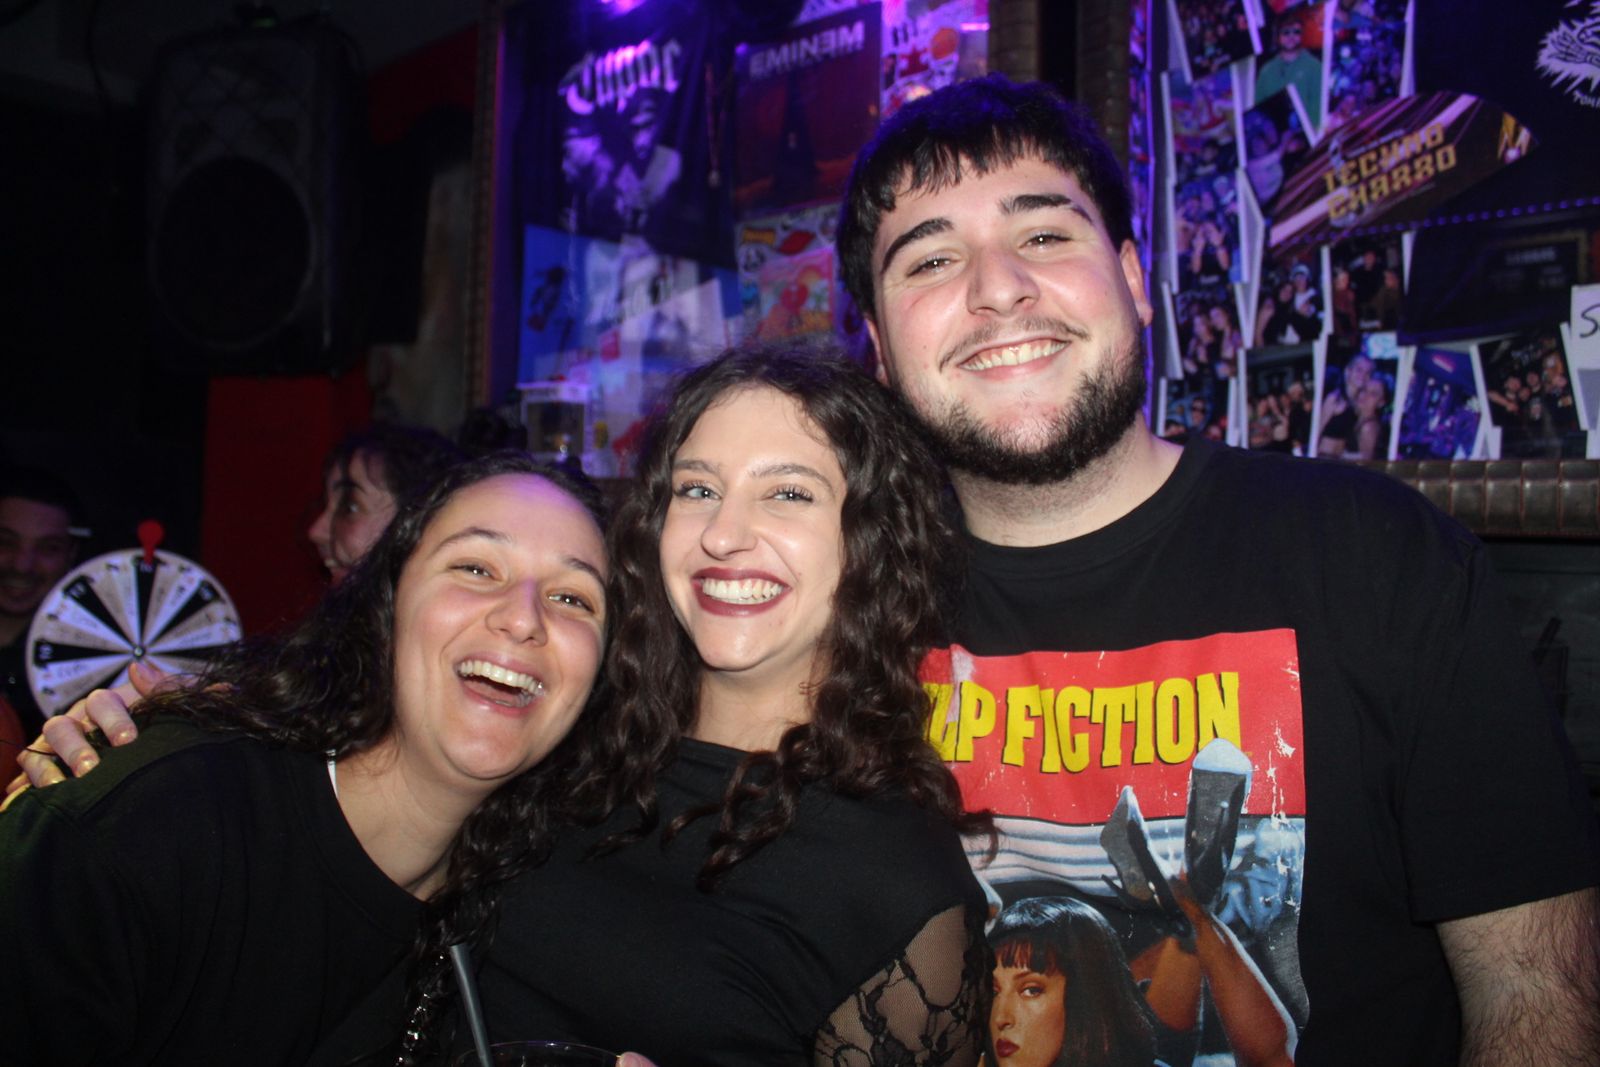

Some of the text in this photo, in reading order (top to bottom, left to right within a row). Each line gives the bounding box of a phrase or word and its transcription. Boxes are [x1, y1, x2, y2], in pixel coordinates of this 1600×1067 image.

[749, 21, 866, 80] EMINEM
[1327, 143, 1457, 219] CHARRO
[1002, 671, 1244, 774] FICTION
